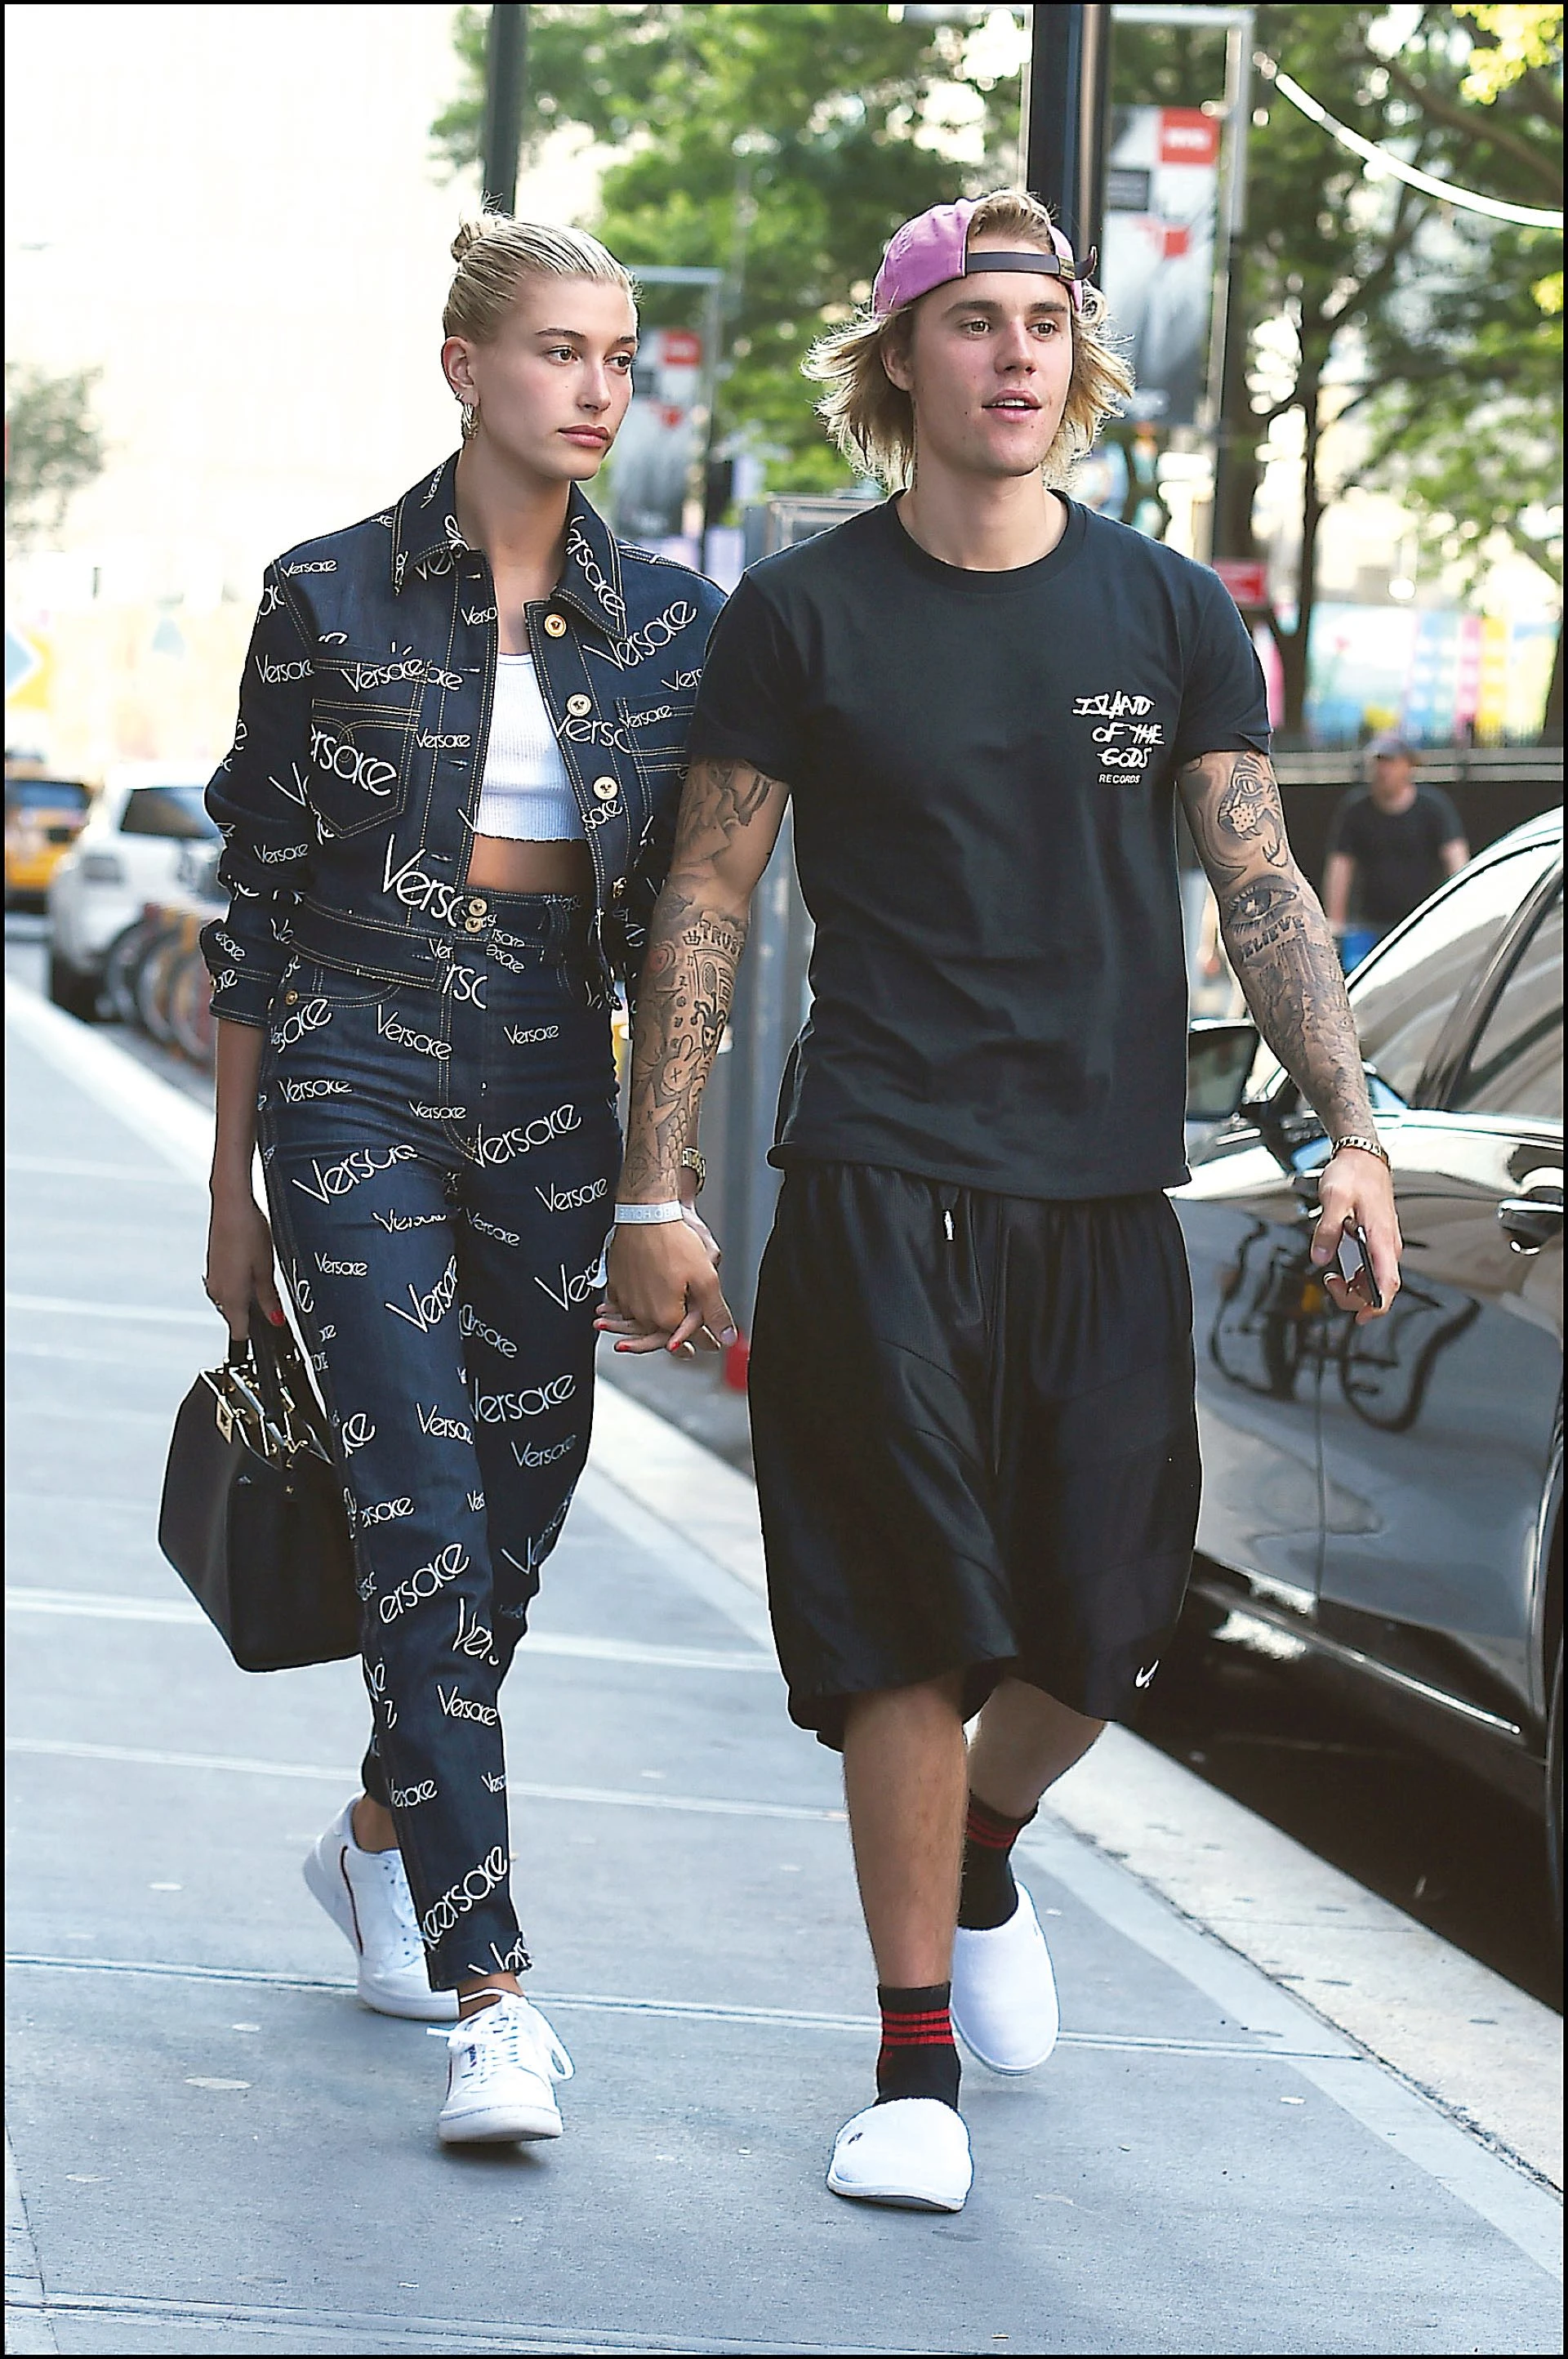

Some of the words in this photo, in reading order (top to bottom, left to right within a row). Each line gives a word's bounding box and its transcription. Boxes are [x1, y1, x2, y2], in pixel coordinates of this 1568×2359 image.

[582, 600, 697, 671] Versace
[1098, 774, 1141, 784] RECORDS
[474, 1104, 581, 1168] Versace
[535, 1178, 608, 1213] Versace
